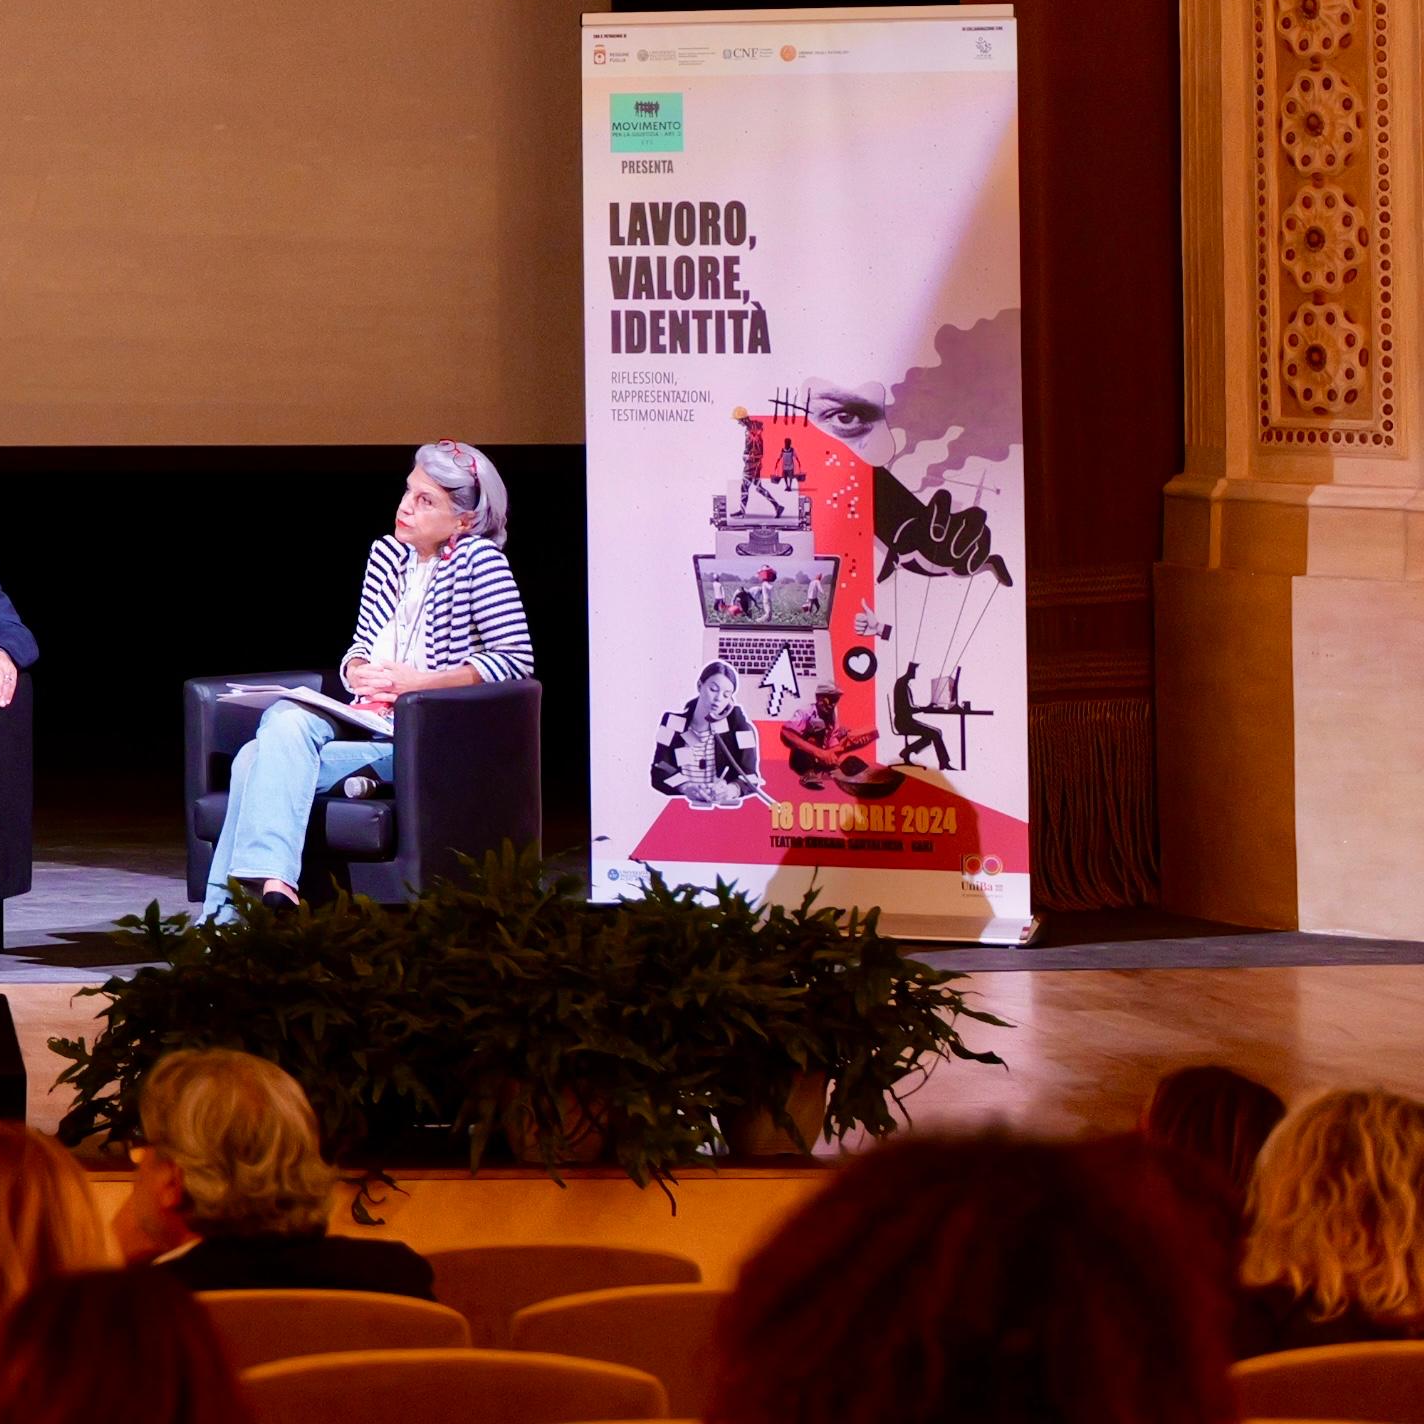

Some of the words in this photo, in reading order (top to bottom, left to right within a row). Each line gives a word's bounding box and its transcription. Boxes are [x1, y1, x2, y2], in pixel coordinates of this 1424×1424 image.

[733, 47, 759, 59] CNF
[612, 121, 681, 131] MOVIMENTO
[621, 160, 674, 174] PRESENTA
[609, 201, 757, 250] LAVORO,
[609, 256, 751, 305] VALORE,
[611, 302, 771, 354] IDENTITÀ
[611, 371, 678, 387] RIFLESSIONI,
[611, 389, 714, 406] RAPPRESENTAZIONI,
[611, 408, 695, 423] TESTIMONIANZE
[769, 801, 794, 831] 18
[799, 802, 896, 833] OTTOBRE
[901, 805, 958, 834] 2024
